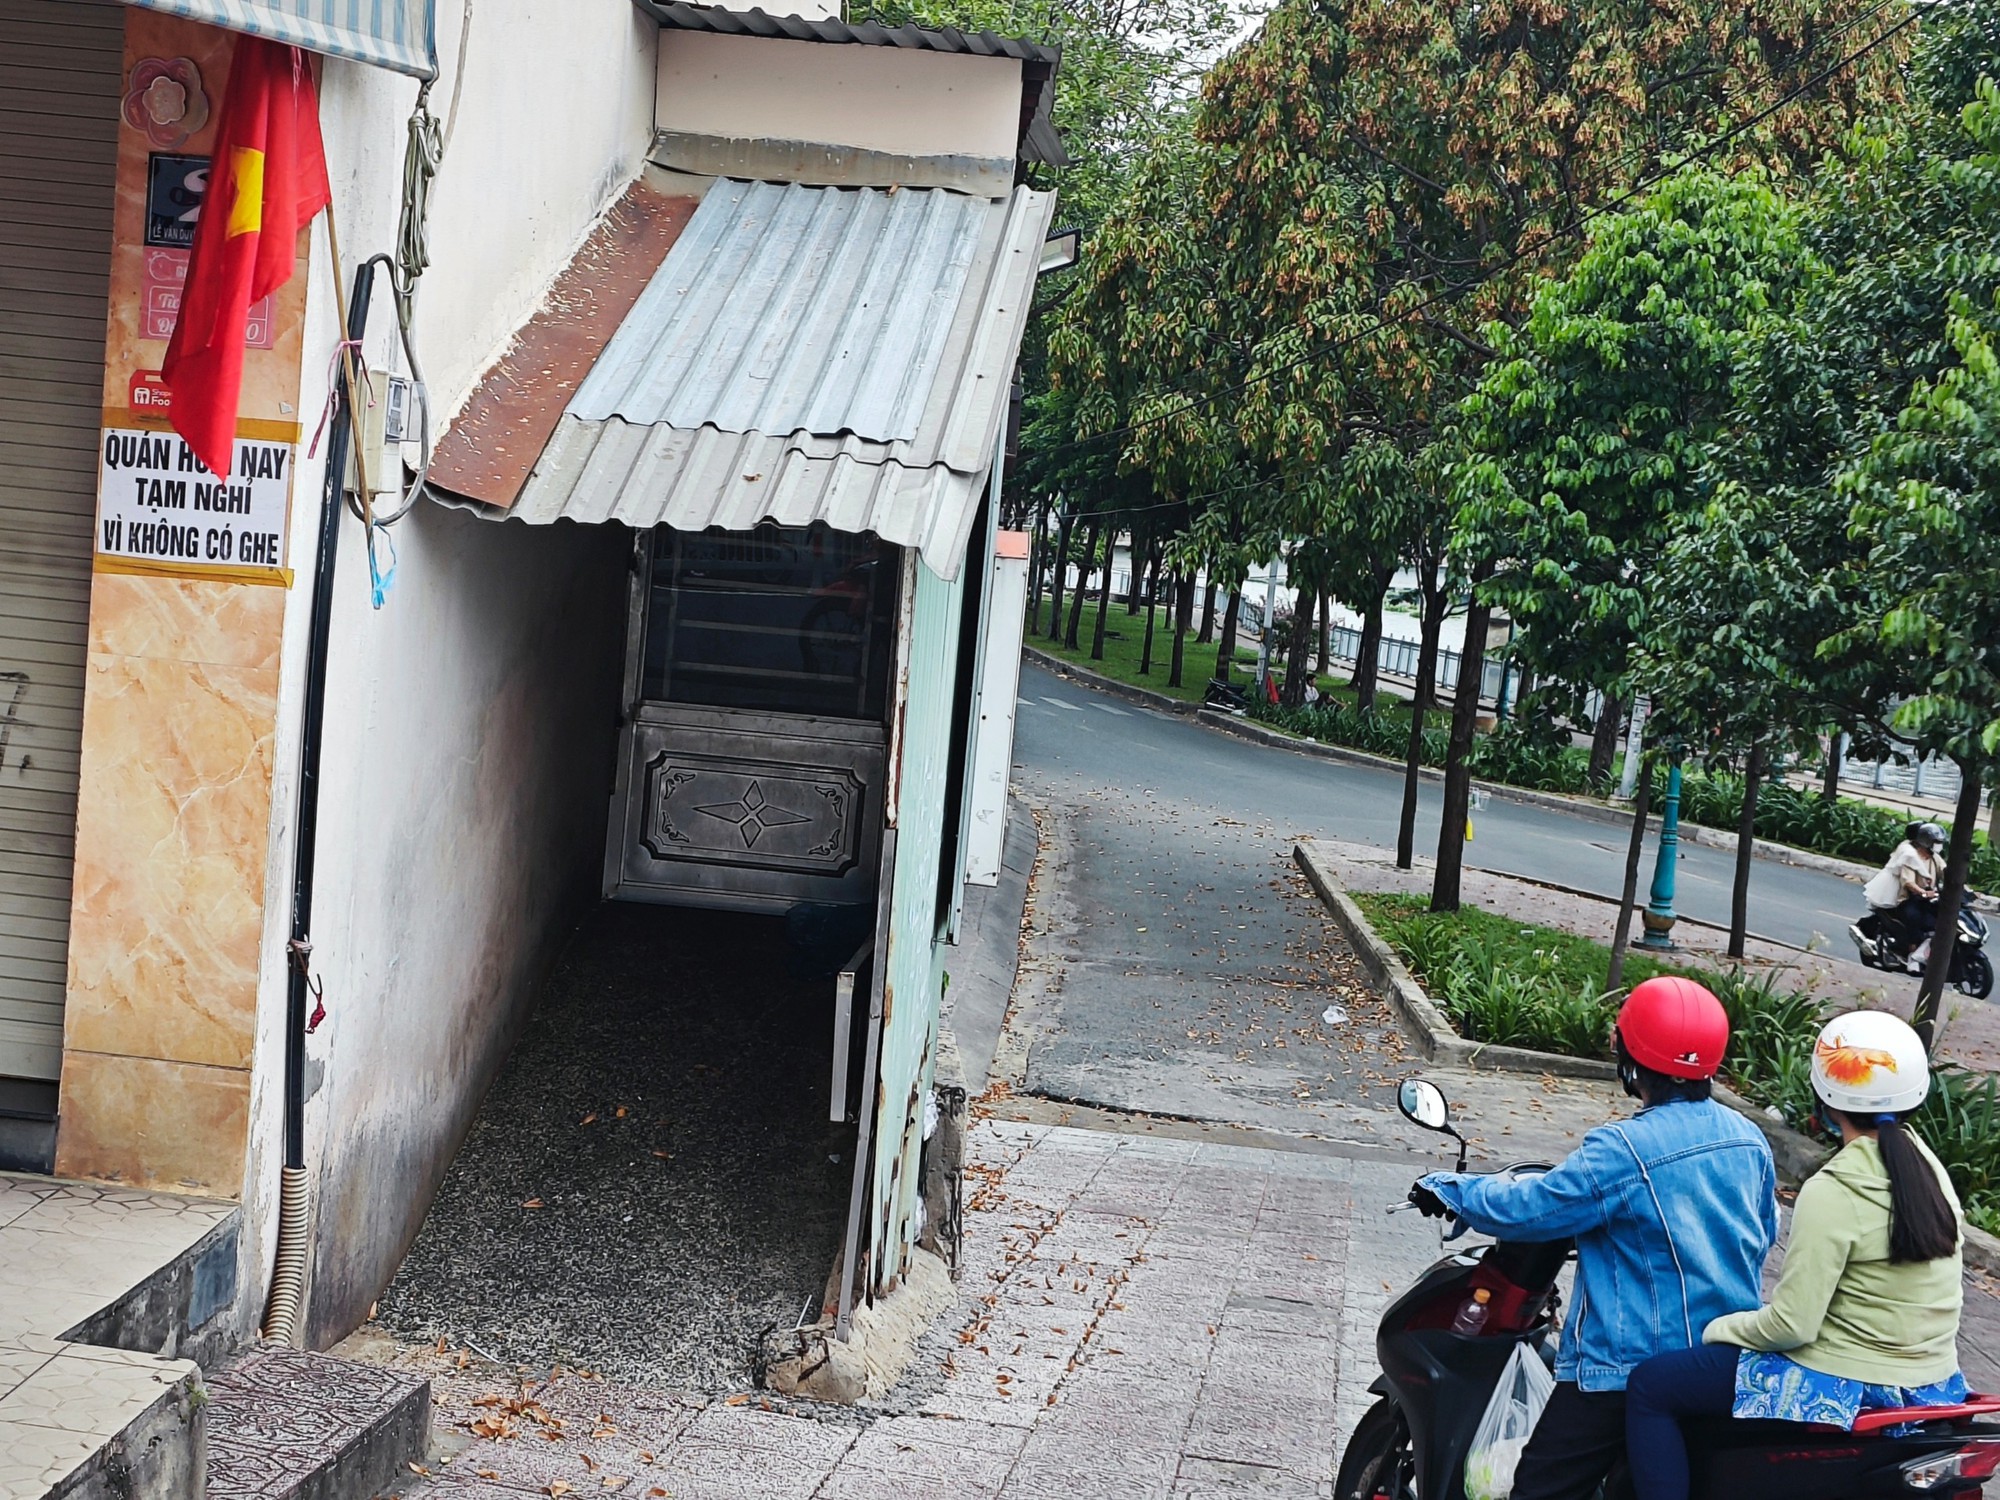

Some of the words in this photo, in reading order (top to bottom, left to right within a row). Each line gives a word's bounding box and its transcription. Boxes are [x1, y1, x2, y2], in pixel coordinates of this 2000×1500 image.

[151, 396, 171, 406] Foo
[105, 429, 171, 471] QUÁN
[240, 445, 287, 480] NAY
[135, 477, 187, 513] TẠM
[194, 477, 253, 515] NGHỈ
[103, 513, 122, 551] VÌ
[127, 517, 199, 558] KHÔNG
[206, 523, 233, 561] CÓ
